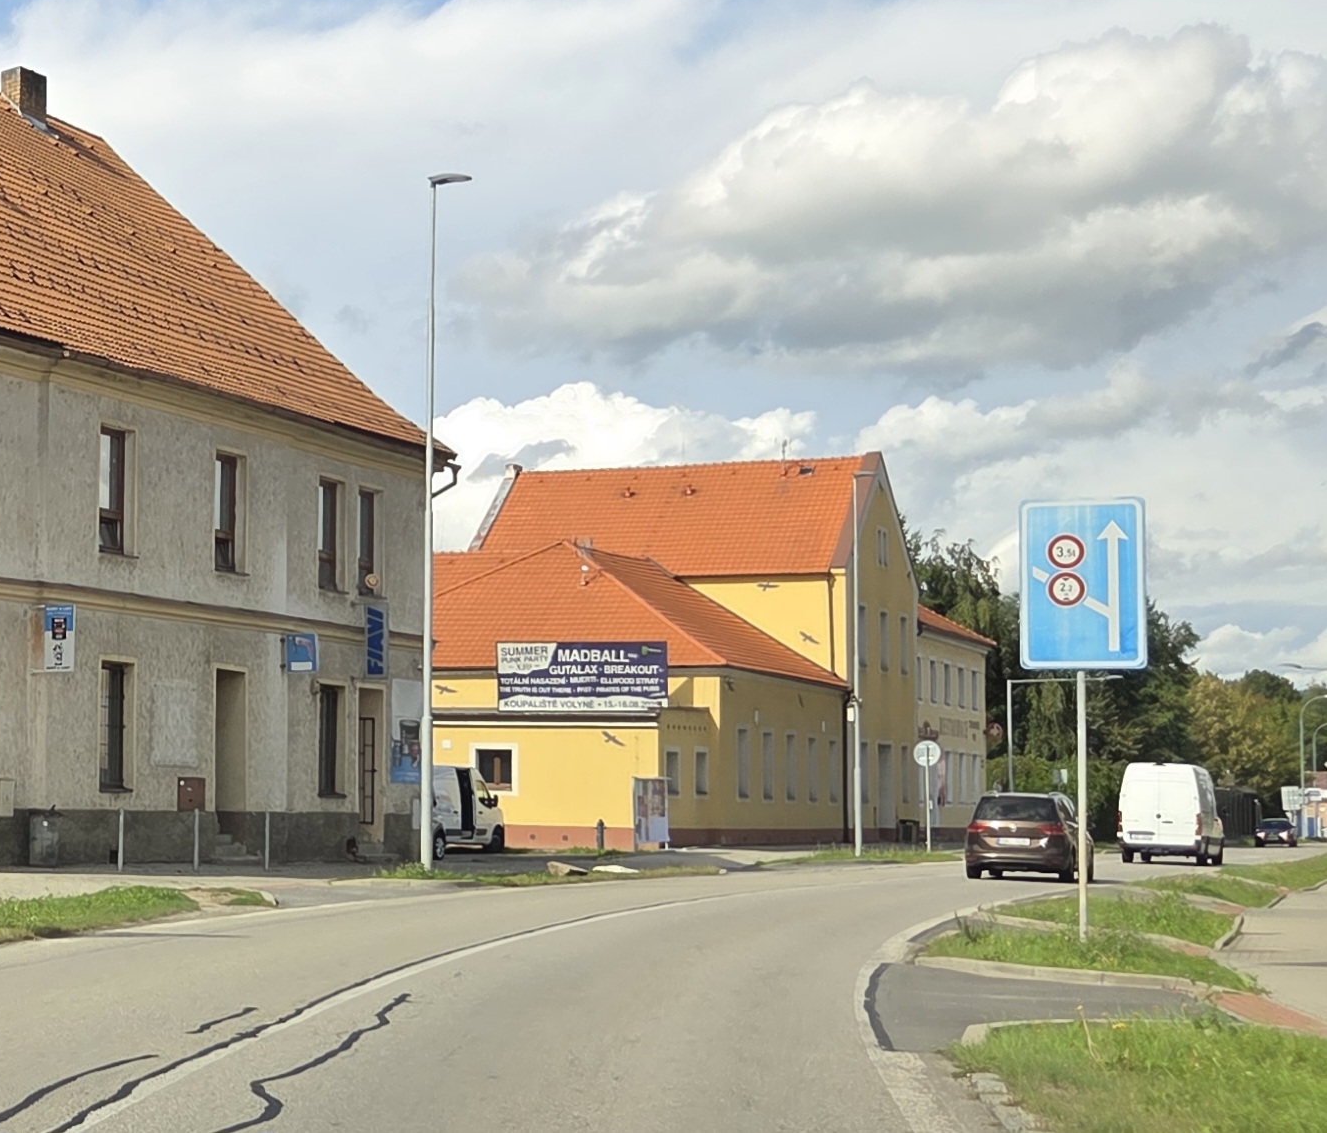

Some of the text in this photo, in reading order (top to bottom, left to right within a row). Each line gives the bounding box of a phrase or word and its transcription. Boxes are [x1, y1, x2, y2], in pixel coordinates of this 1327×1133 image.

[500, 646, 548, 656] SUMMER
[557, 649, 630, 662] MADBALL
[549, 665, 659, 675] GUTALAX BREAKOUT
